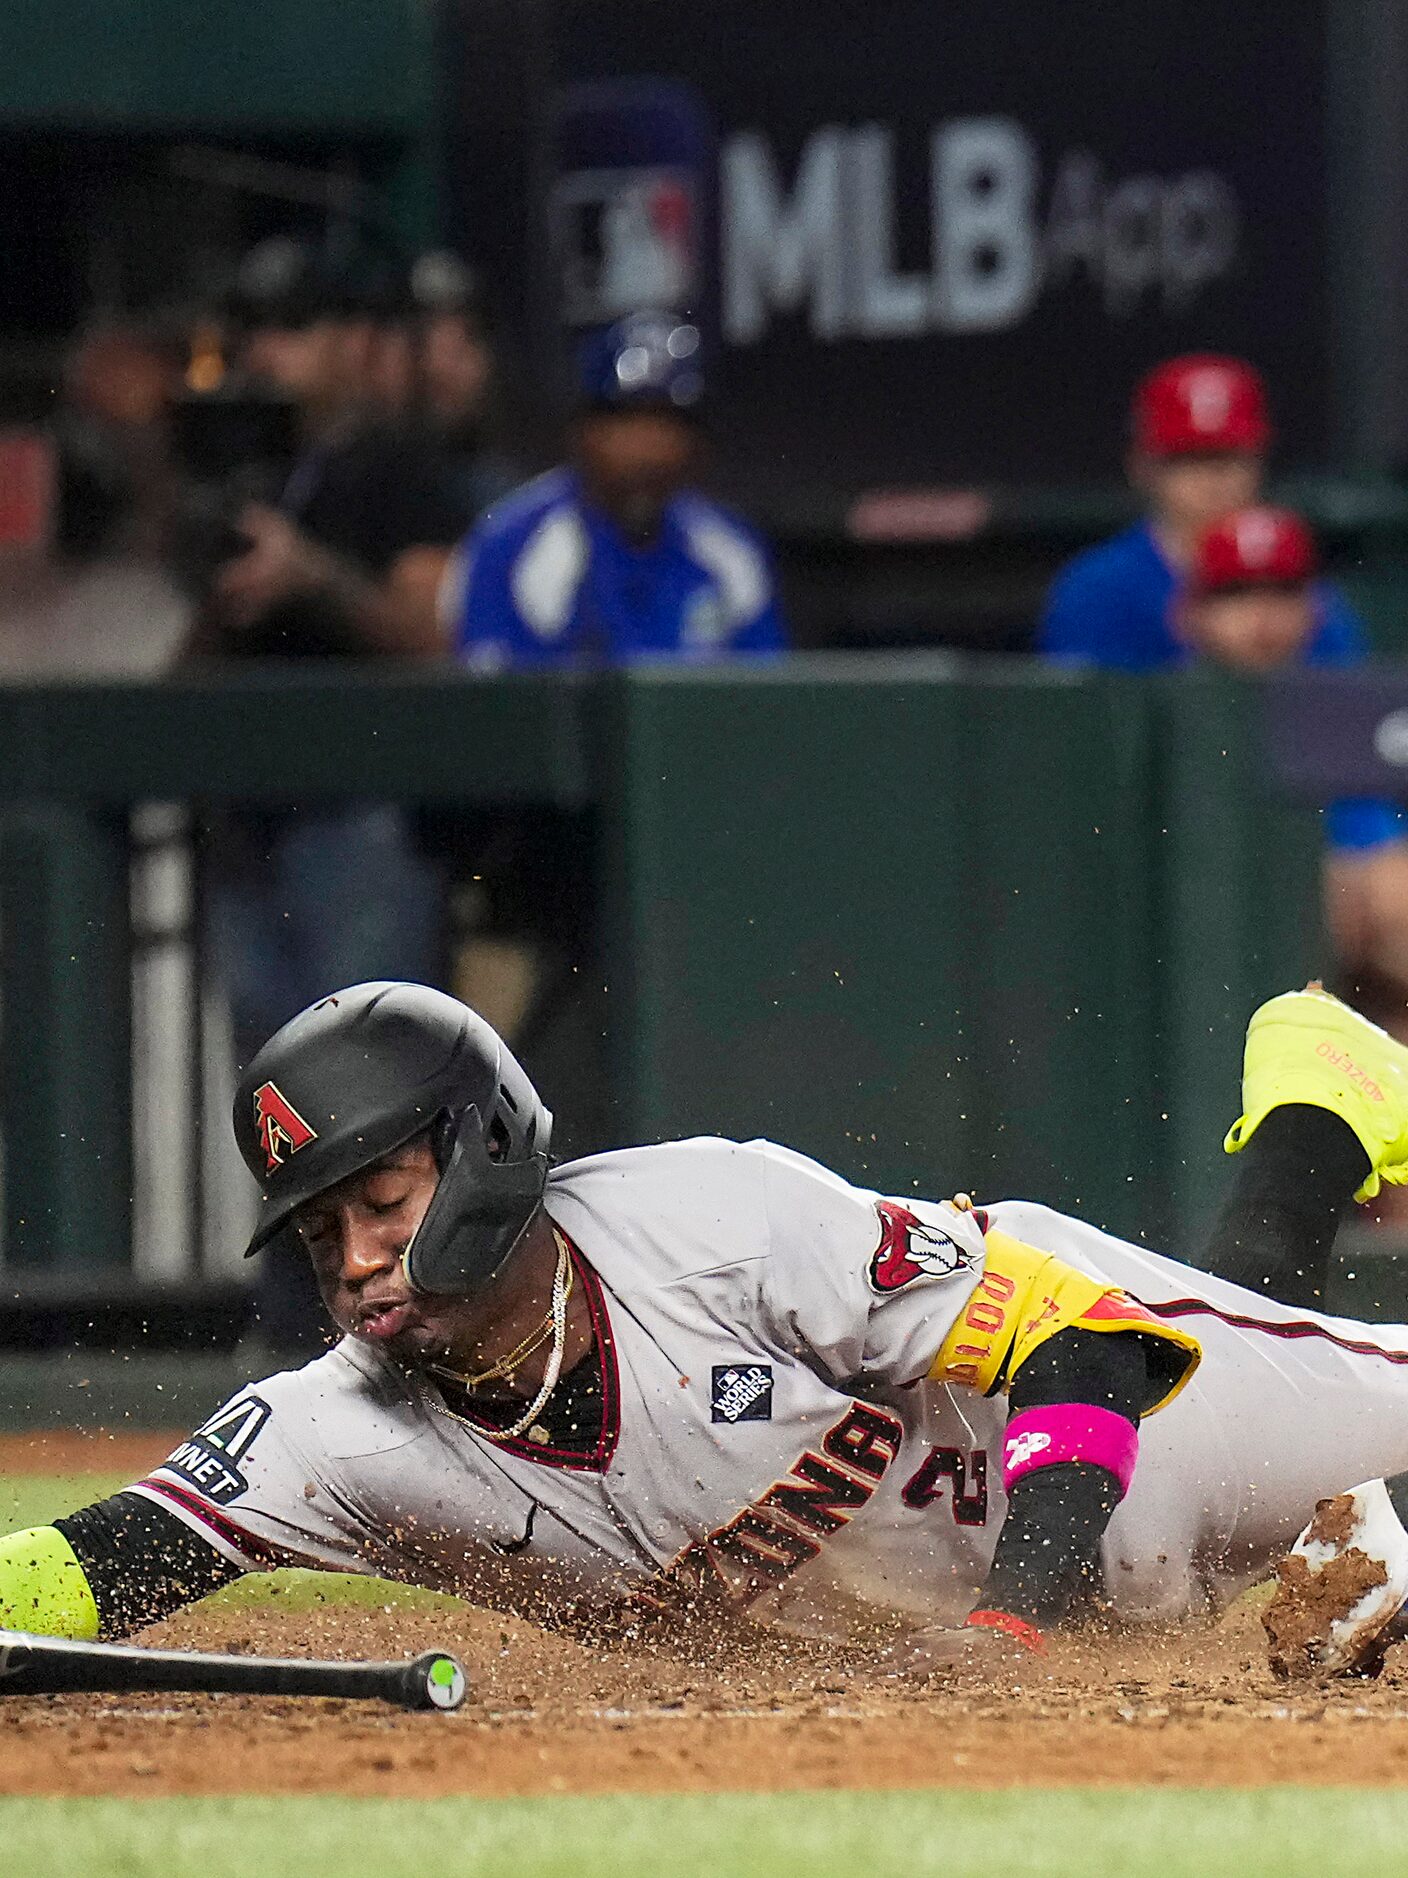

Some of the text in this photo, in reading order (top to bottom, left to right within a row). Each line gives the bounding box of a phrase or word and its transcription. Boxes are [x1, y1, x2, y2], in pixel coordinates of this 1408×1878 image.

[720, 115, 1240, 343] MLB App
[713, 1367, 762, 1411] WORLD
[724, 1374, 773, 1422] SERIES
[901, 1446, 988, 1527] 2
